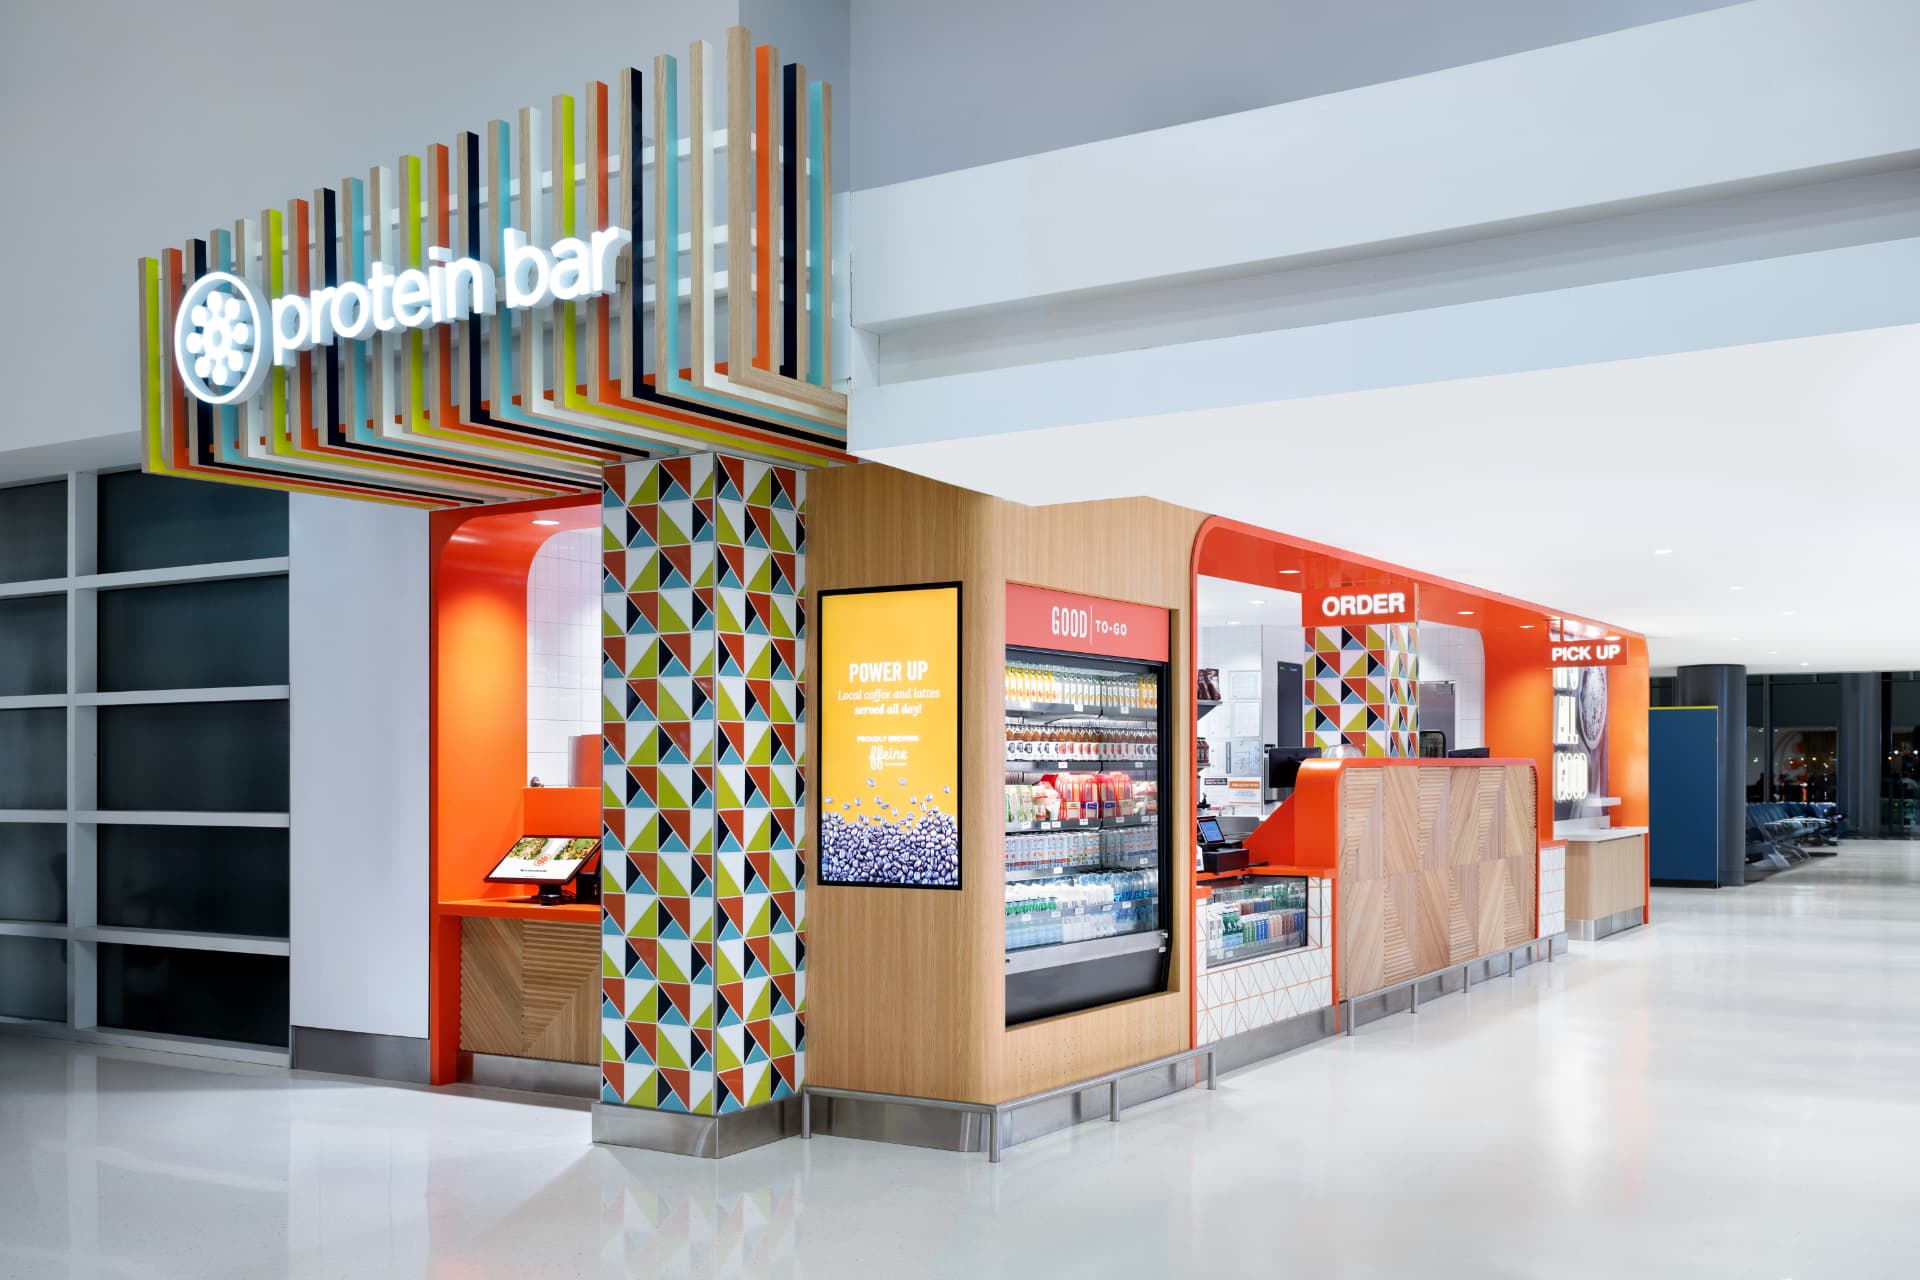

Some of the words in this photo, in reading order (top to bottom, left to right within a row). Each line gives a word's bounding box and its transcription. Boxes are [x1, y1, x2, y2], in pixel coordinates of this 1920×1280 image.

[271, 246, 497, 367] protein
[502, 226, 631, 309] bar
[1322, 592, 1405, 617] ORDER
[1051, 605, 1088, 639] GOOD
[1095, 619, 1127, 637] TO-GO
[1552, 646, 1592, 662] PICK
[1596, 644, 1621, 660] UP
[849, 661, 903, 683] POWER
[907, 660, 928, 681] UP
[838, 689, 862, 701] Local
[864, 688, 891, 703] coffee
[893, 687, 912, 699] and
[913, 687, 940, 699] lattes
[854, 703, 885, 715] served
[887, 703, 899, 715] all
[901, 703, 922, 717] day!
